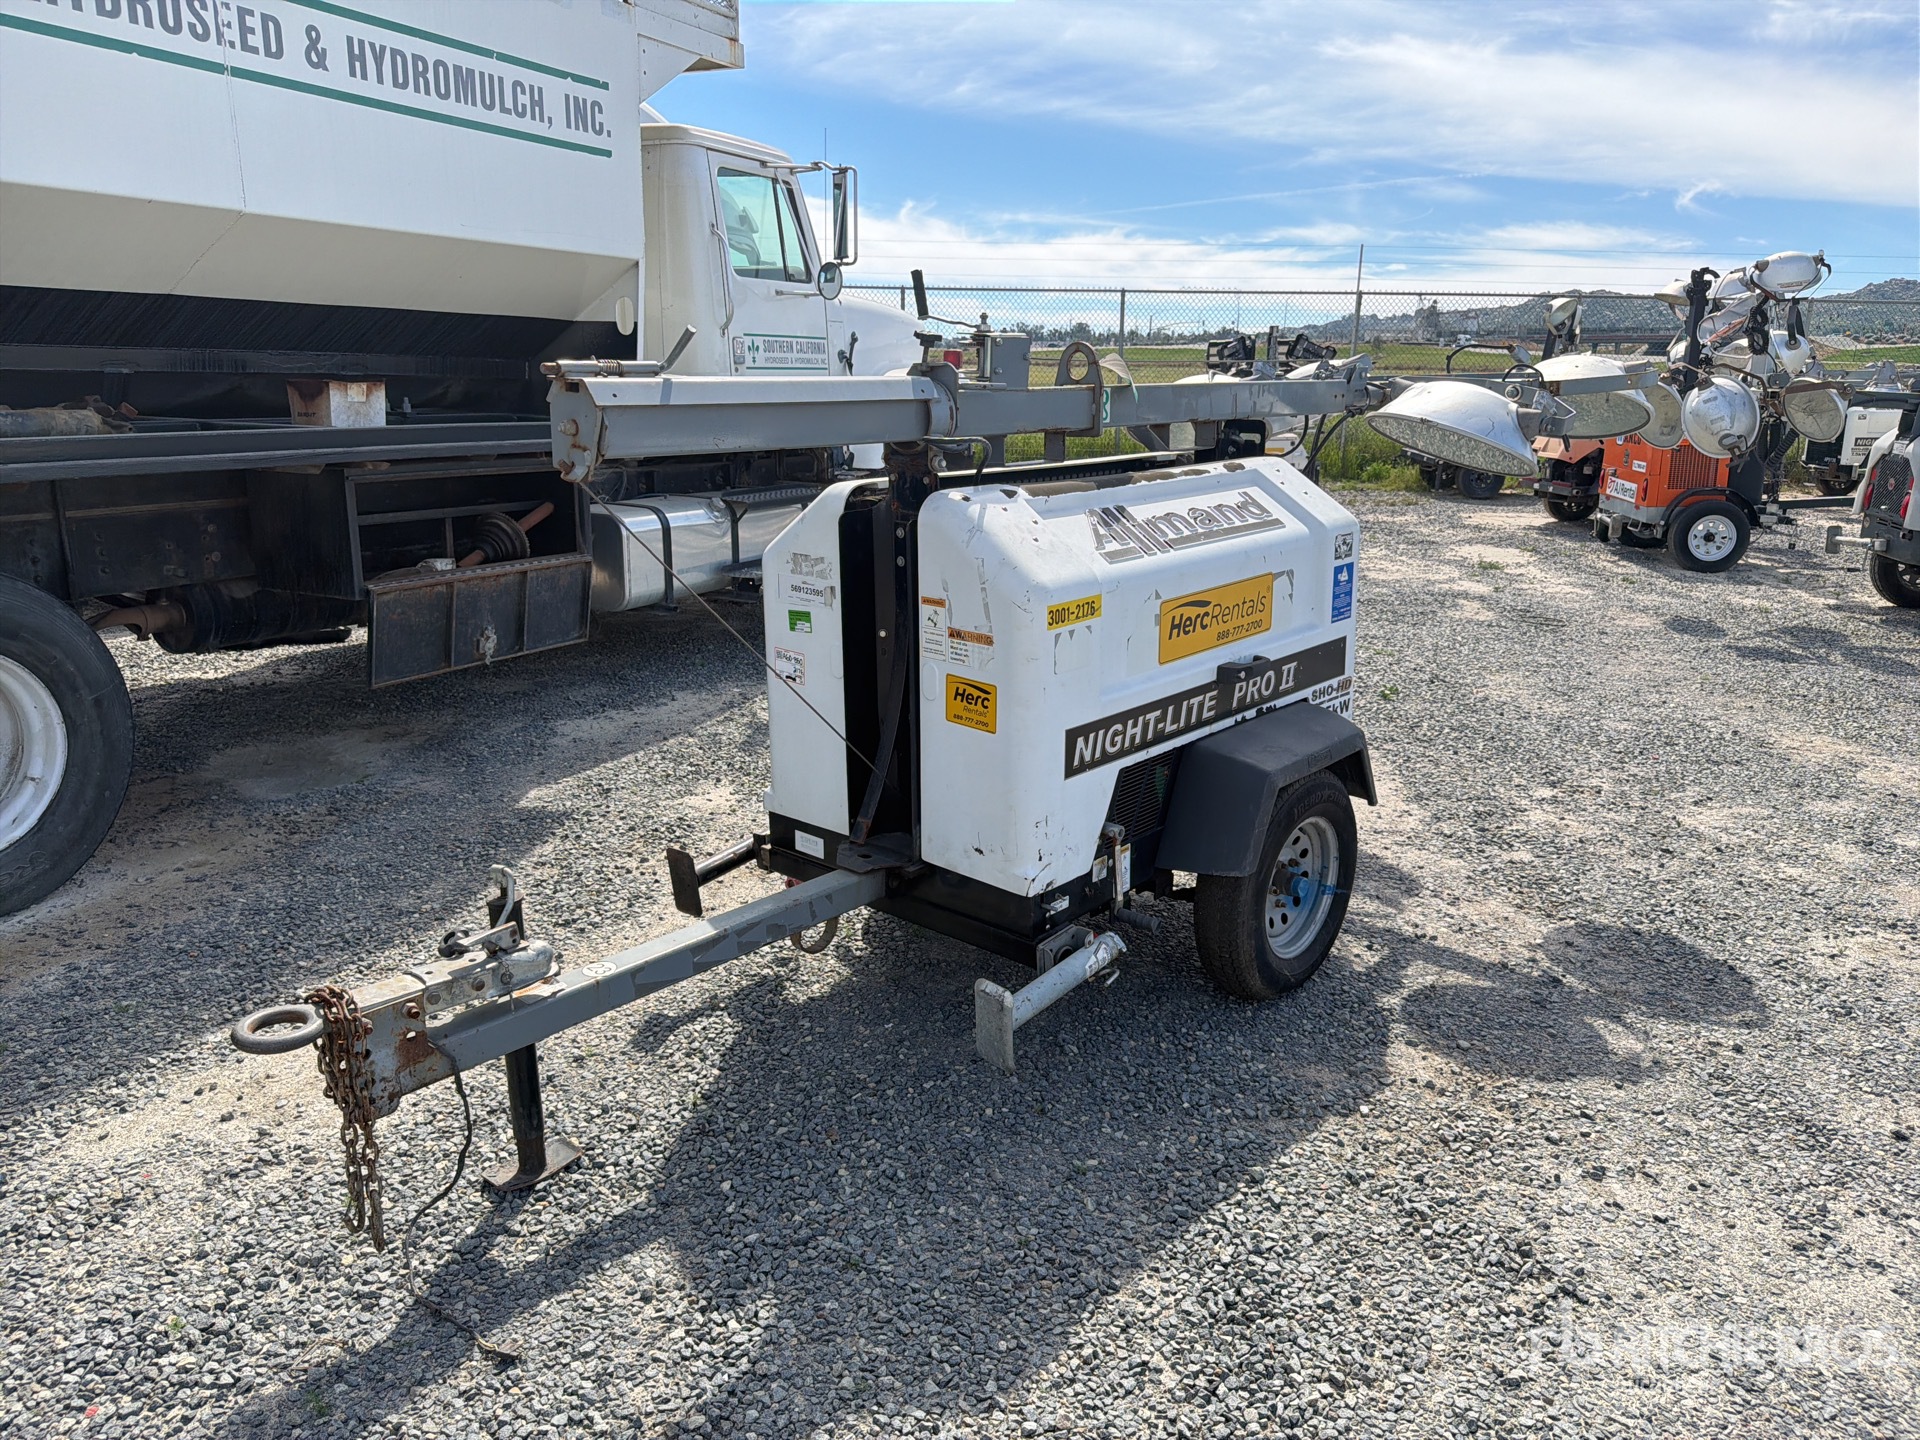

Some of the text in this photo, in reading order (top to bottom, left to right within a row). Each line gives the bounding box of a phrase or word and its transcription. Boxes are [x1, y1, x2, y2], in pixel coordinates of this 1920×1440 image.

[305, 24, 329, 71] &
[346, 35, 554, 131] HYDROMULCH,
[564, 92, 612, 139] INC.
[763, 339, 794, 354] SOUTHERN
[796, 339, 826, 355] CALIFORNIA
[764, 356, 789, 365] HYDROSEED
[790, 357, 794, 365] &
[1085, 491, 1274, 556] Allmand
[790, 584, 824, 598] 569123595
[1048, 600, 1096, 627] 3001-2176
[955, 630, 993, 646] WARNING
[1216, 618, 1263, 642] 888-777-2700
[953, 686, 990, 710] Herc
[1311, 676, 1352, 702] SHO-HD
[953, 713, 989, 729] 888-777-2700
[963, 704, 988, 718] Rentals
[1072, 690, 1218, 771] NIGHT-LITE
[1231, 668, 1276, 710] PRO
[1279, 662, 1299, 693] II
